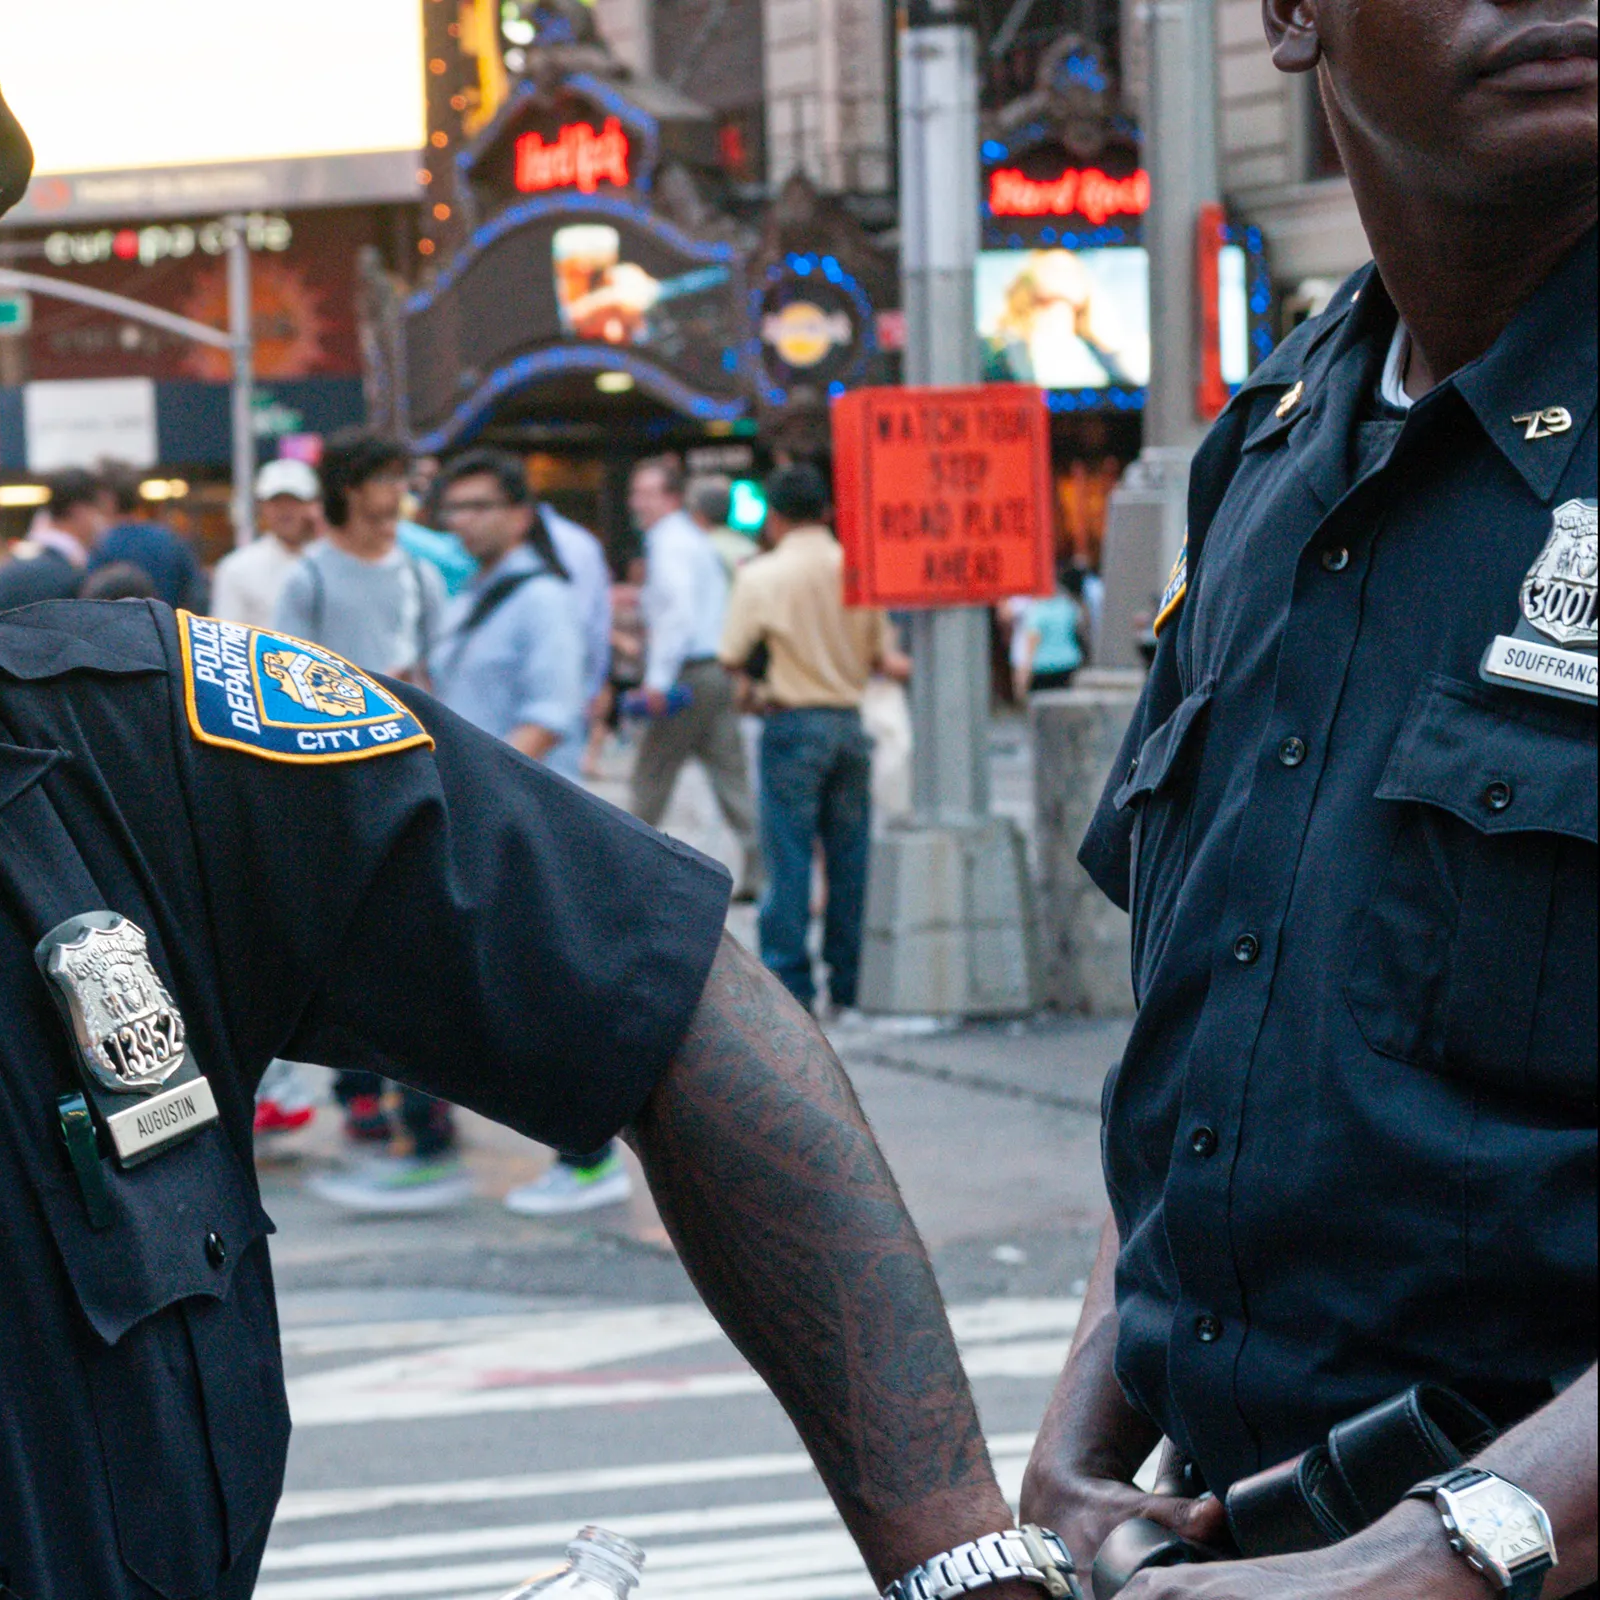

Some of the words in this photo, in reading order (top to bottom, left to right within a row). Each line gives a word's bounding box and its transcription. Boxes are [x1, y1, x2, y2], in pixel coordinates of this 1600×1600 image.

[877, 406, 968, 445] WATCH
[1511, 404, 1572, 440] 79
[880, 502, 949, 542] ROAD
[1524, 579, 1598, 630] 3001
[1504, 647, 1598, 686] SOUFFRANC
[296, 729, 361, 751] CITY
[368, 721, 403, 743] OF
[109, 1007, 184, 1080] 13952
[136, 1095, 197, 1139] AUGUSTIN
